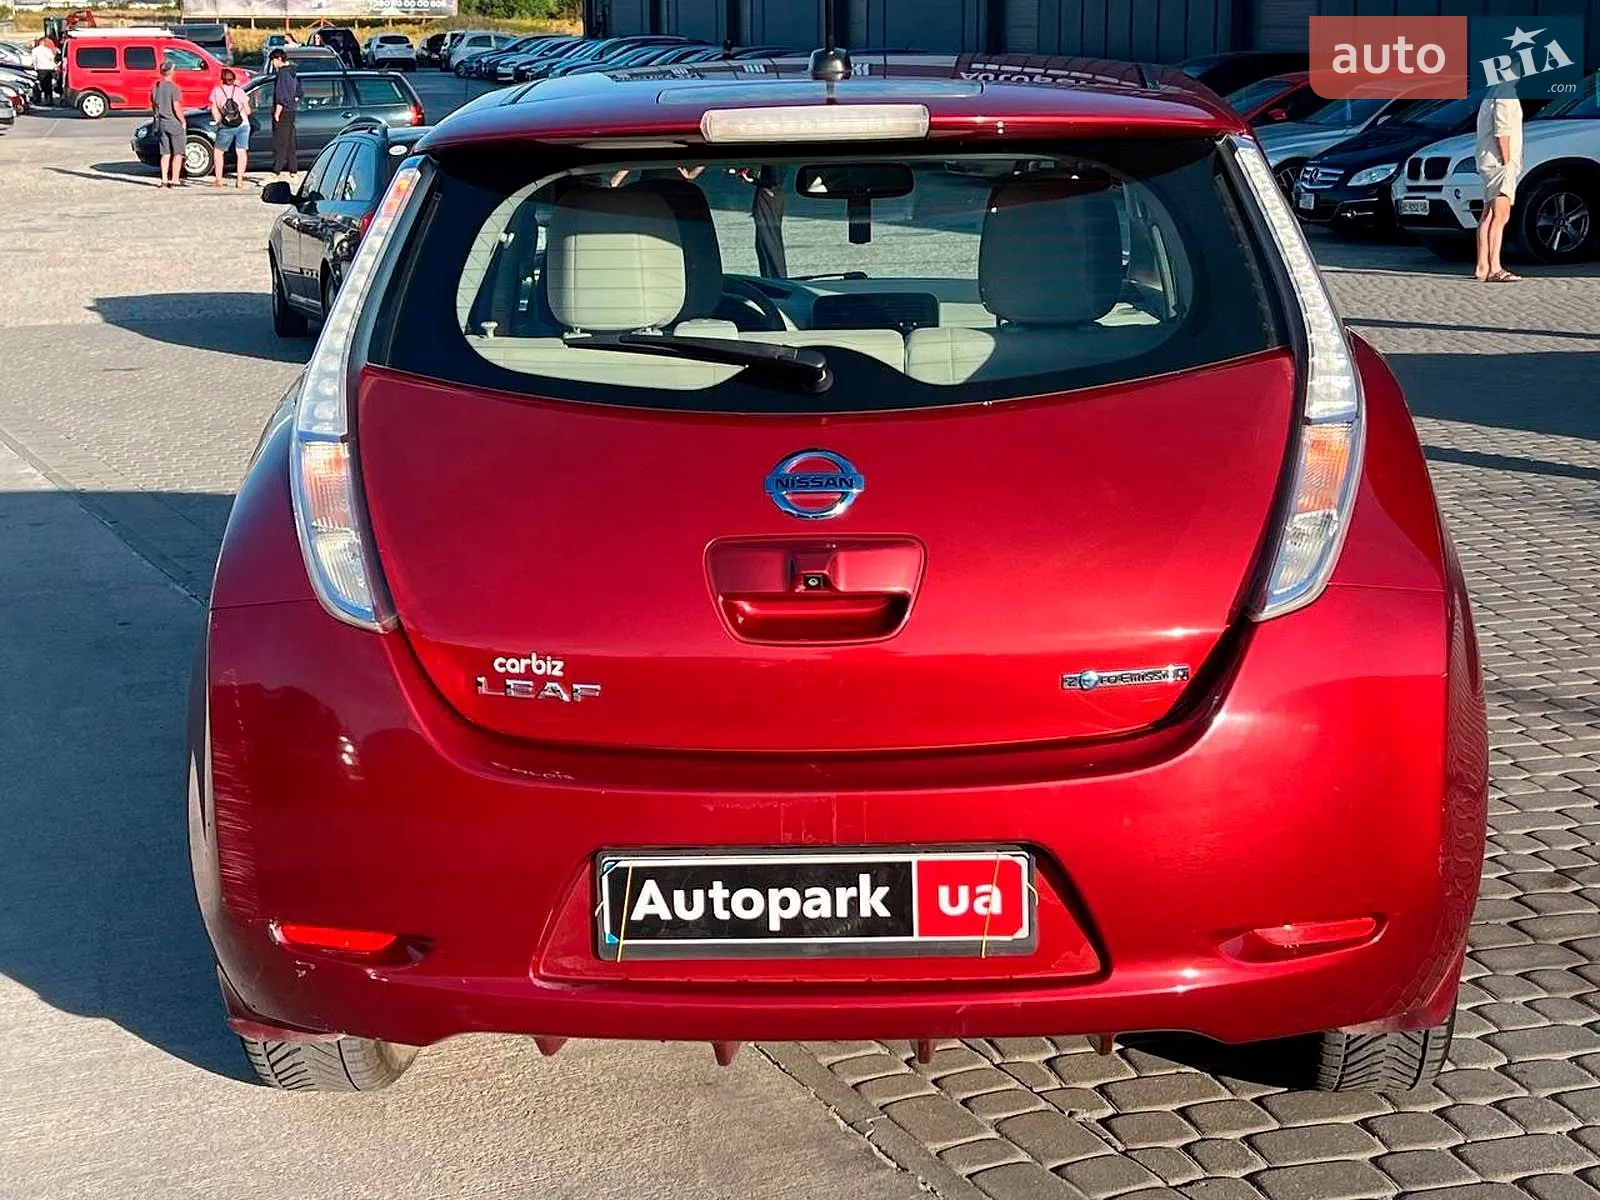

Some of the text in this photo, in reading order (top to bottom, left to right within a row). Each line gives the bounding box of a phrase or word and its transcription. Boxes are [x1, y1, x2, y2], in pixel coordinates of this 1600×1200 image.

[775, 475, 854, 489] NISSAN
[493, 652, 565, 677] carbiz
[476, 676, 602, 702] LEAF
[630, 873, 1003, 932] Autopark ua
